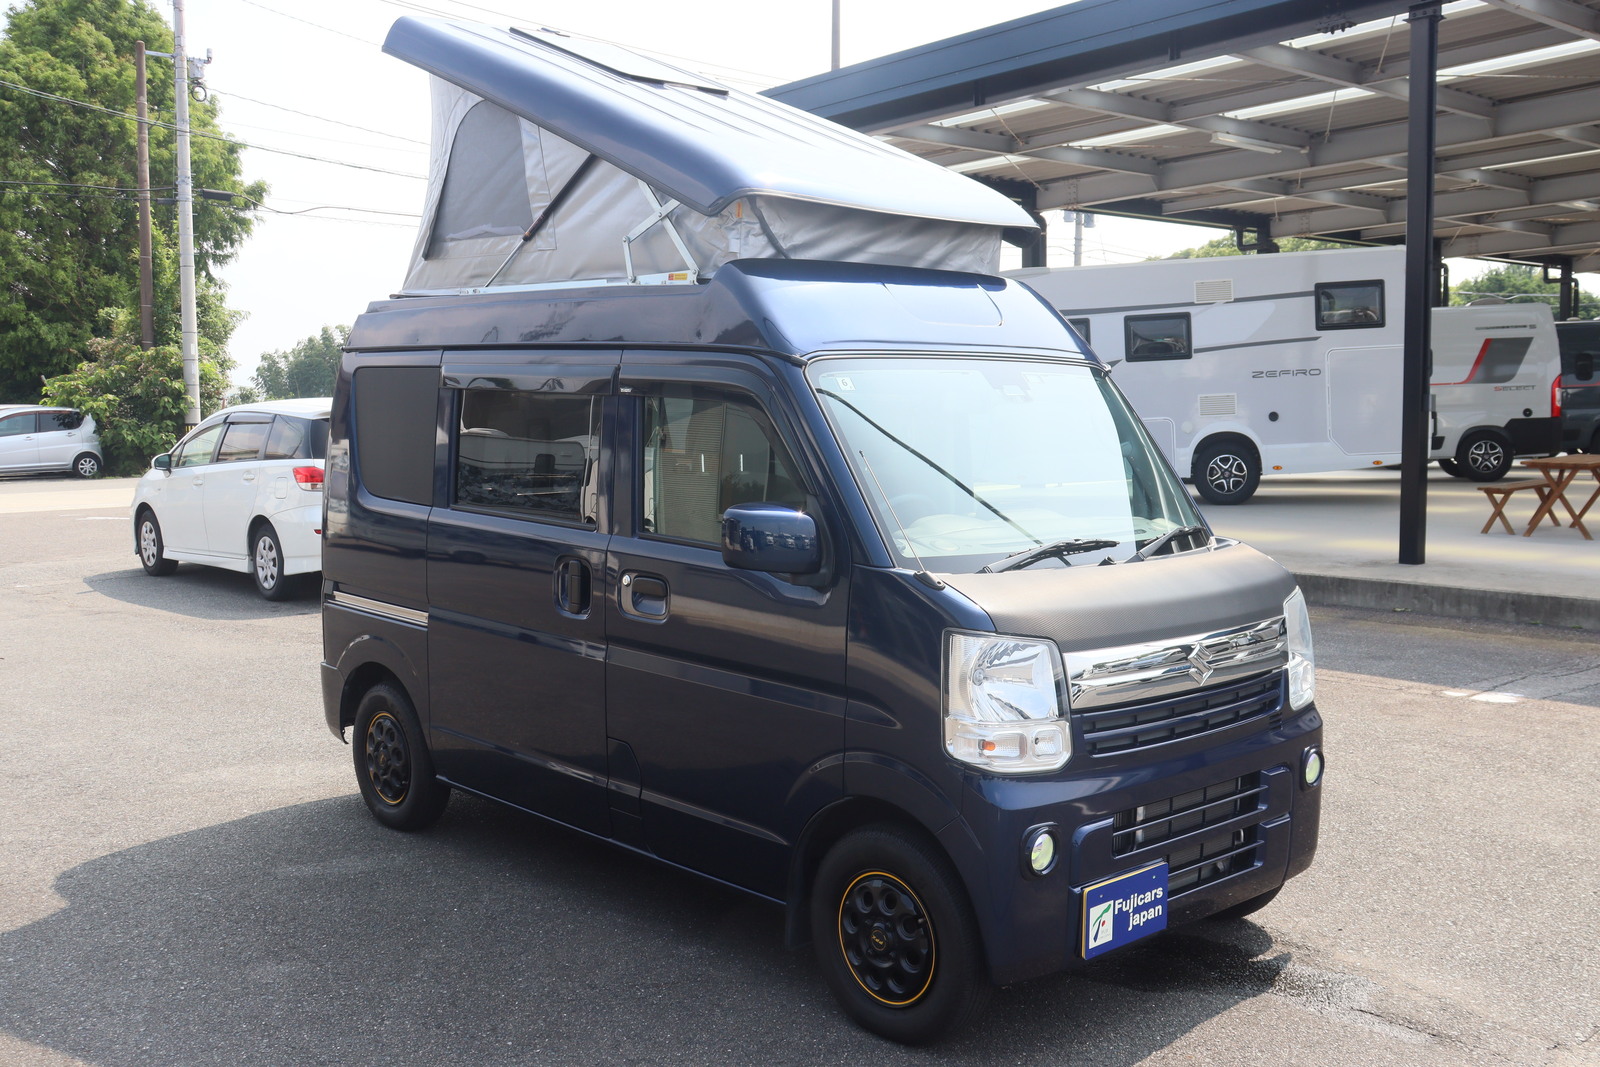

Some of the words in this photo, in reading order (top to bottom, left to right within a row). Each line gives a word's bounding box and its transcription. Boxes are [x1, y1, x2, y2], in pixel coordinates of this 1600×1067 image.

[1251, 368, 1322, 379] ZEFIRO
[1115, 887, 1163, 915] Fujicars
[1127, 904, 1163, 931] japan
